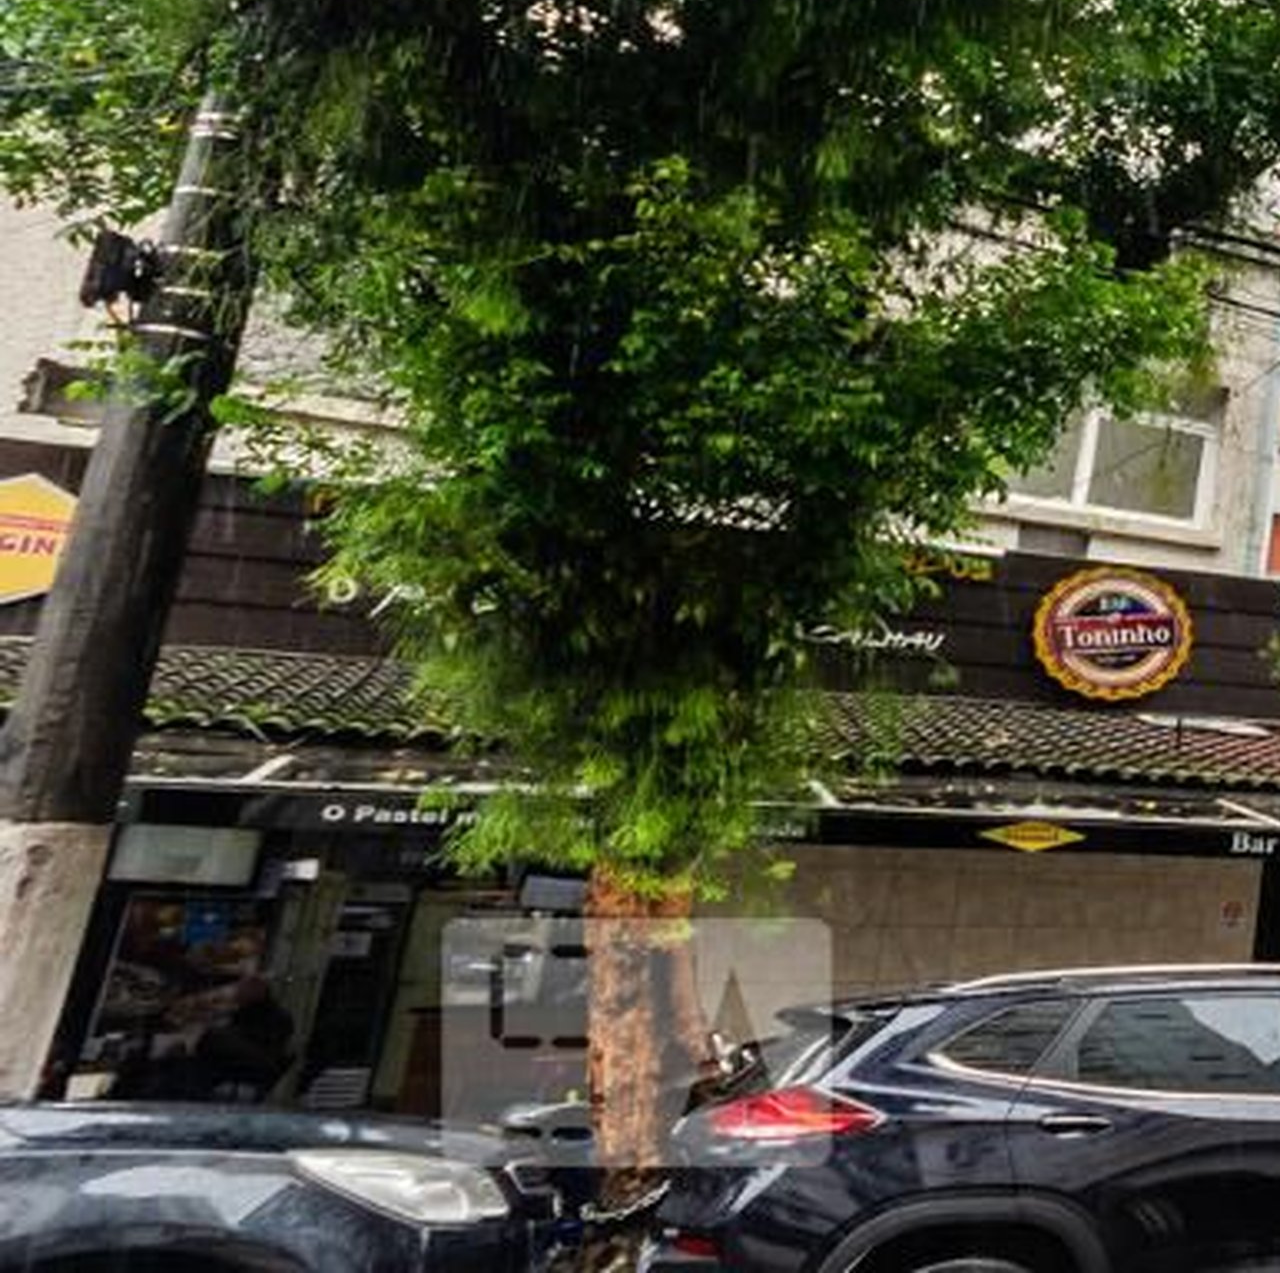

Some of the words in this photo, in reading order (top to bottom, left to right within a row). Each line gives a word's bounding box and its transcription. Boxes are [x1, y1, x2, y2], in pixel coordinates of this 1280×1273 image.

[1056, 622, 1171, 648] Toninho
[322, 804, 346, 822] O
[353, 804, 448, 824] Pastel
[1230, 831, 1280, 854] Bar
